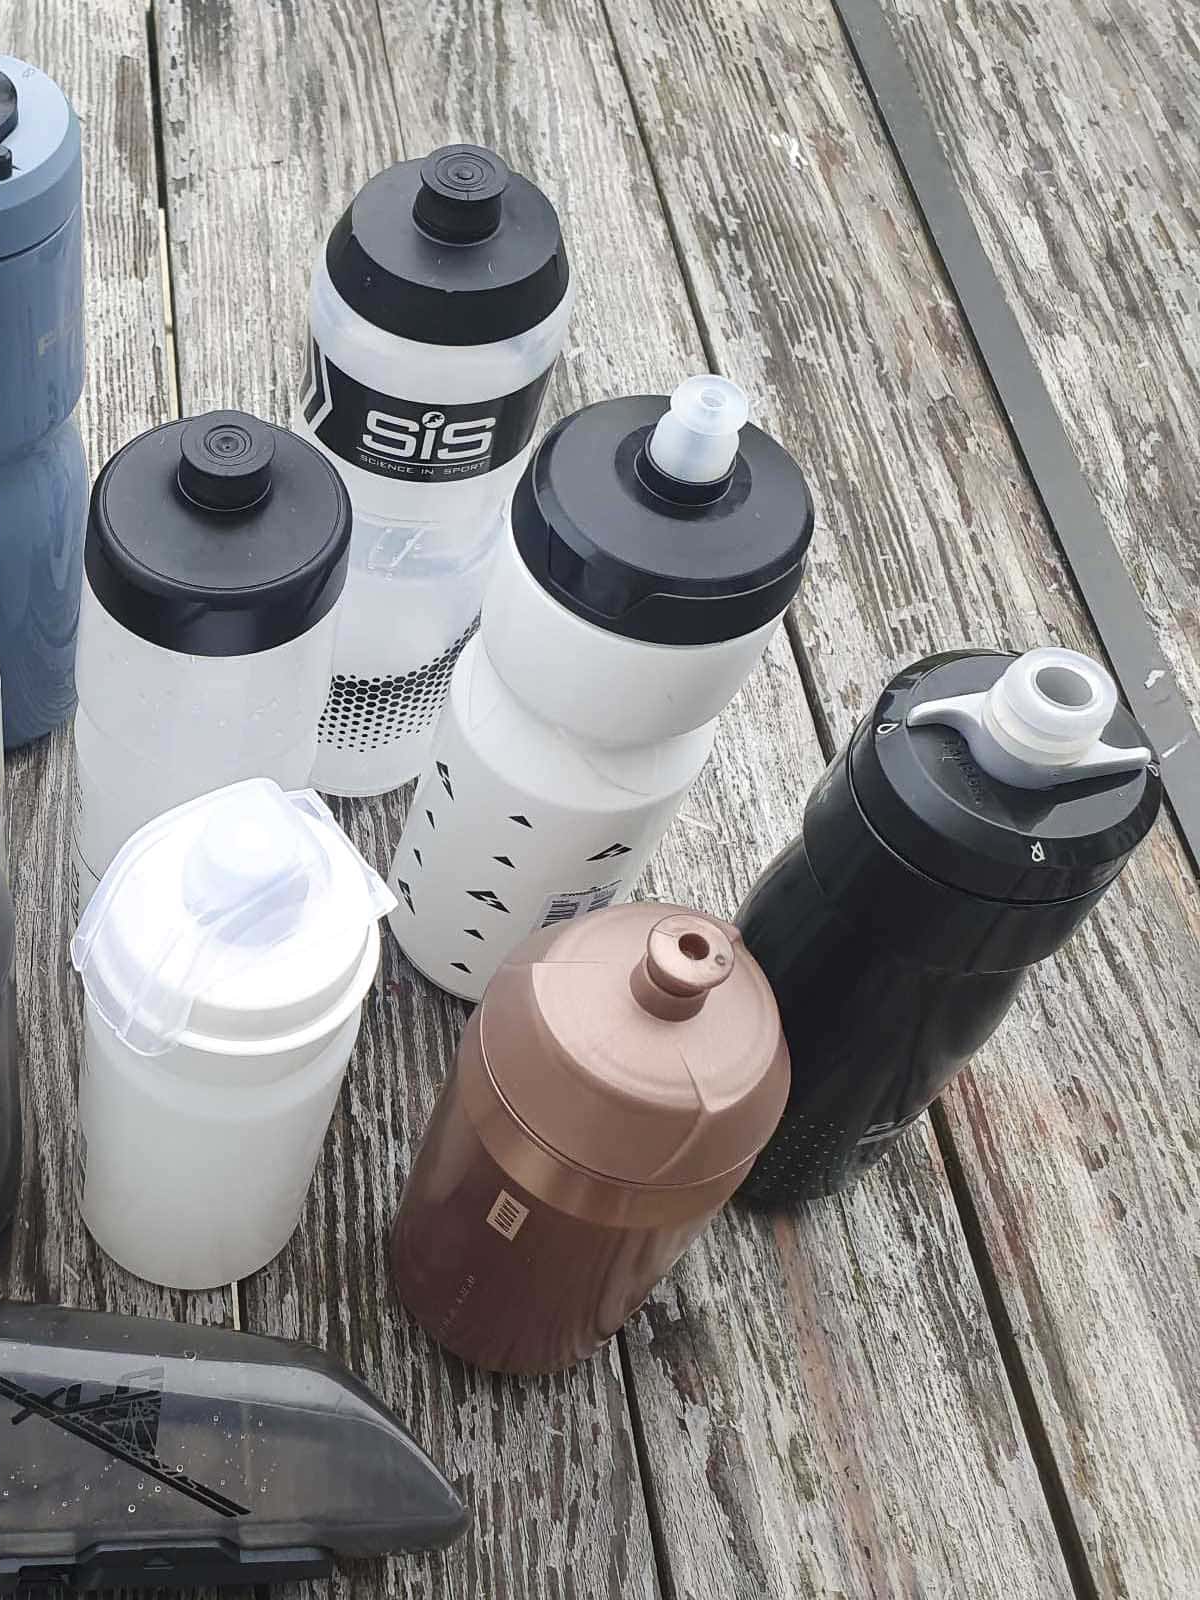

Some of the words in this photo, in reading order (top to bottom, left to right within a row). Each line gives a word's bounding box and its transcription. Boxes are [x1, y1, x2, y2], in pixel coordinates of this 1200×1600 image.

[362, 410, 497, 460] SiS
[359, 454, 416, 474] SCIENCE
[420, 467, 435, 476] IN
[443, 460, 490, 476] SPORT
